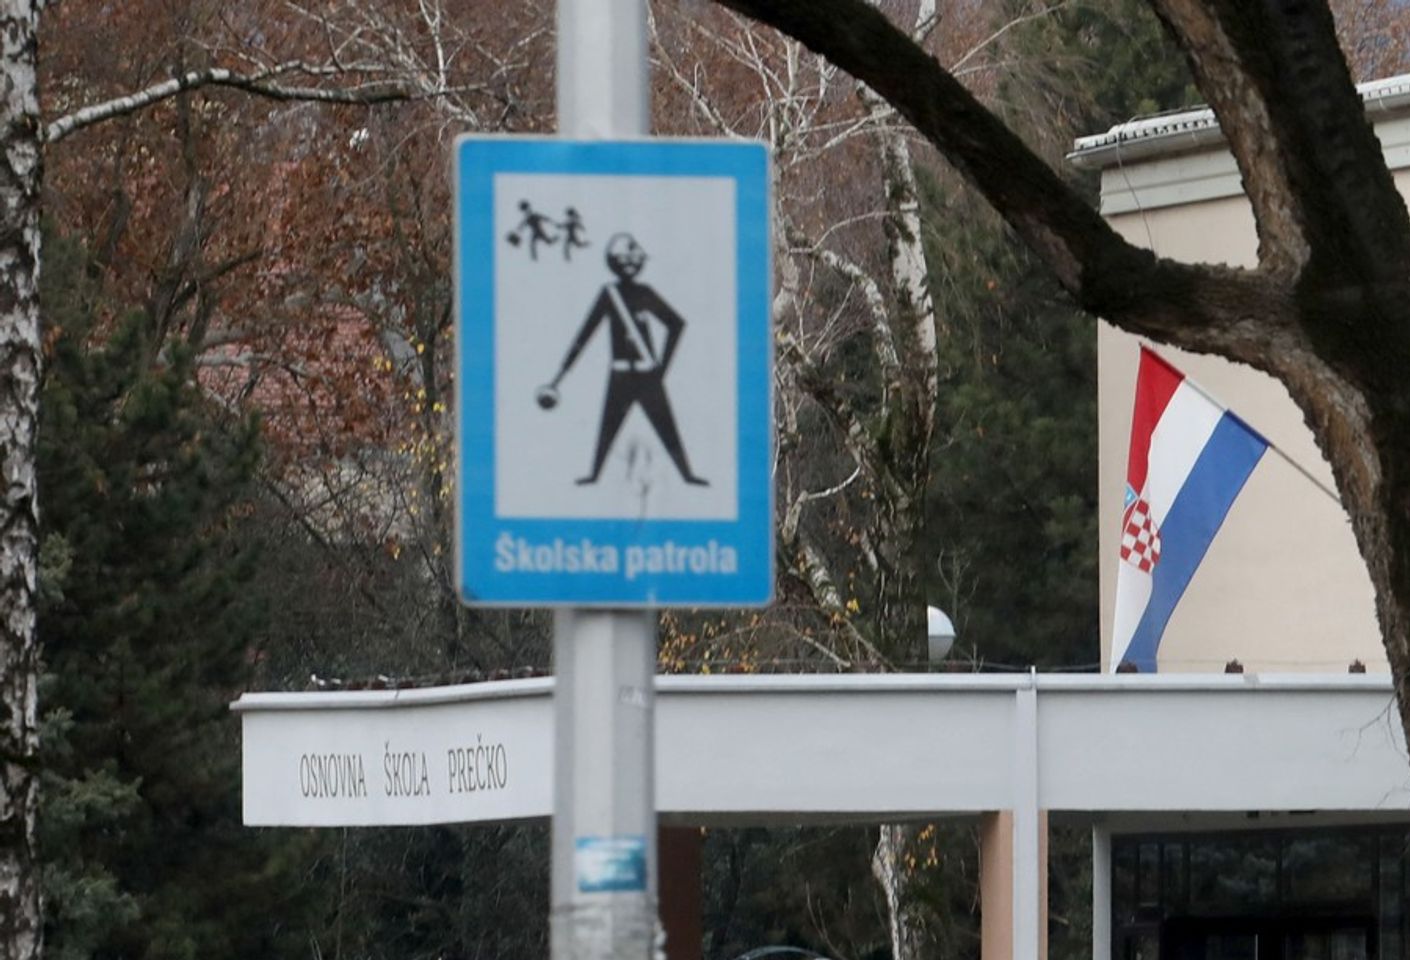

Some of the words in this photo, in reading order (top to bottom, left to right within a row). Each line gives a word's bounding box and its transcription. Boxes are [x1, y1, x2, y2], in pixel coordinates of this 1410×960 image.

[495, 530, 619, 574] Školska
[625, 538, 739, 582] patrola
[299, 752, 367, 799] OSNOVNA
[383, 739, 430, 798] ŠKOLA
[448, 732, 508, 794] PREČKO
